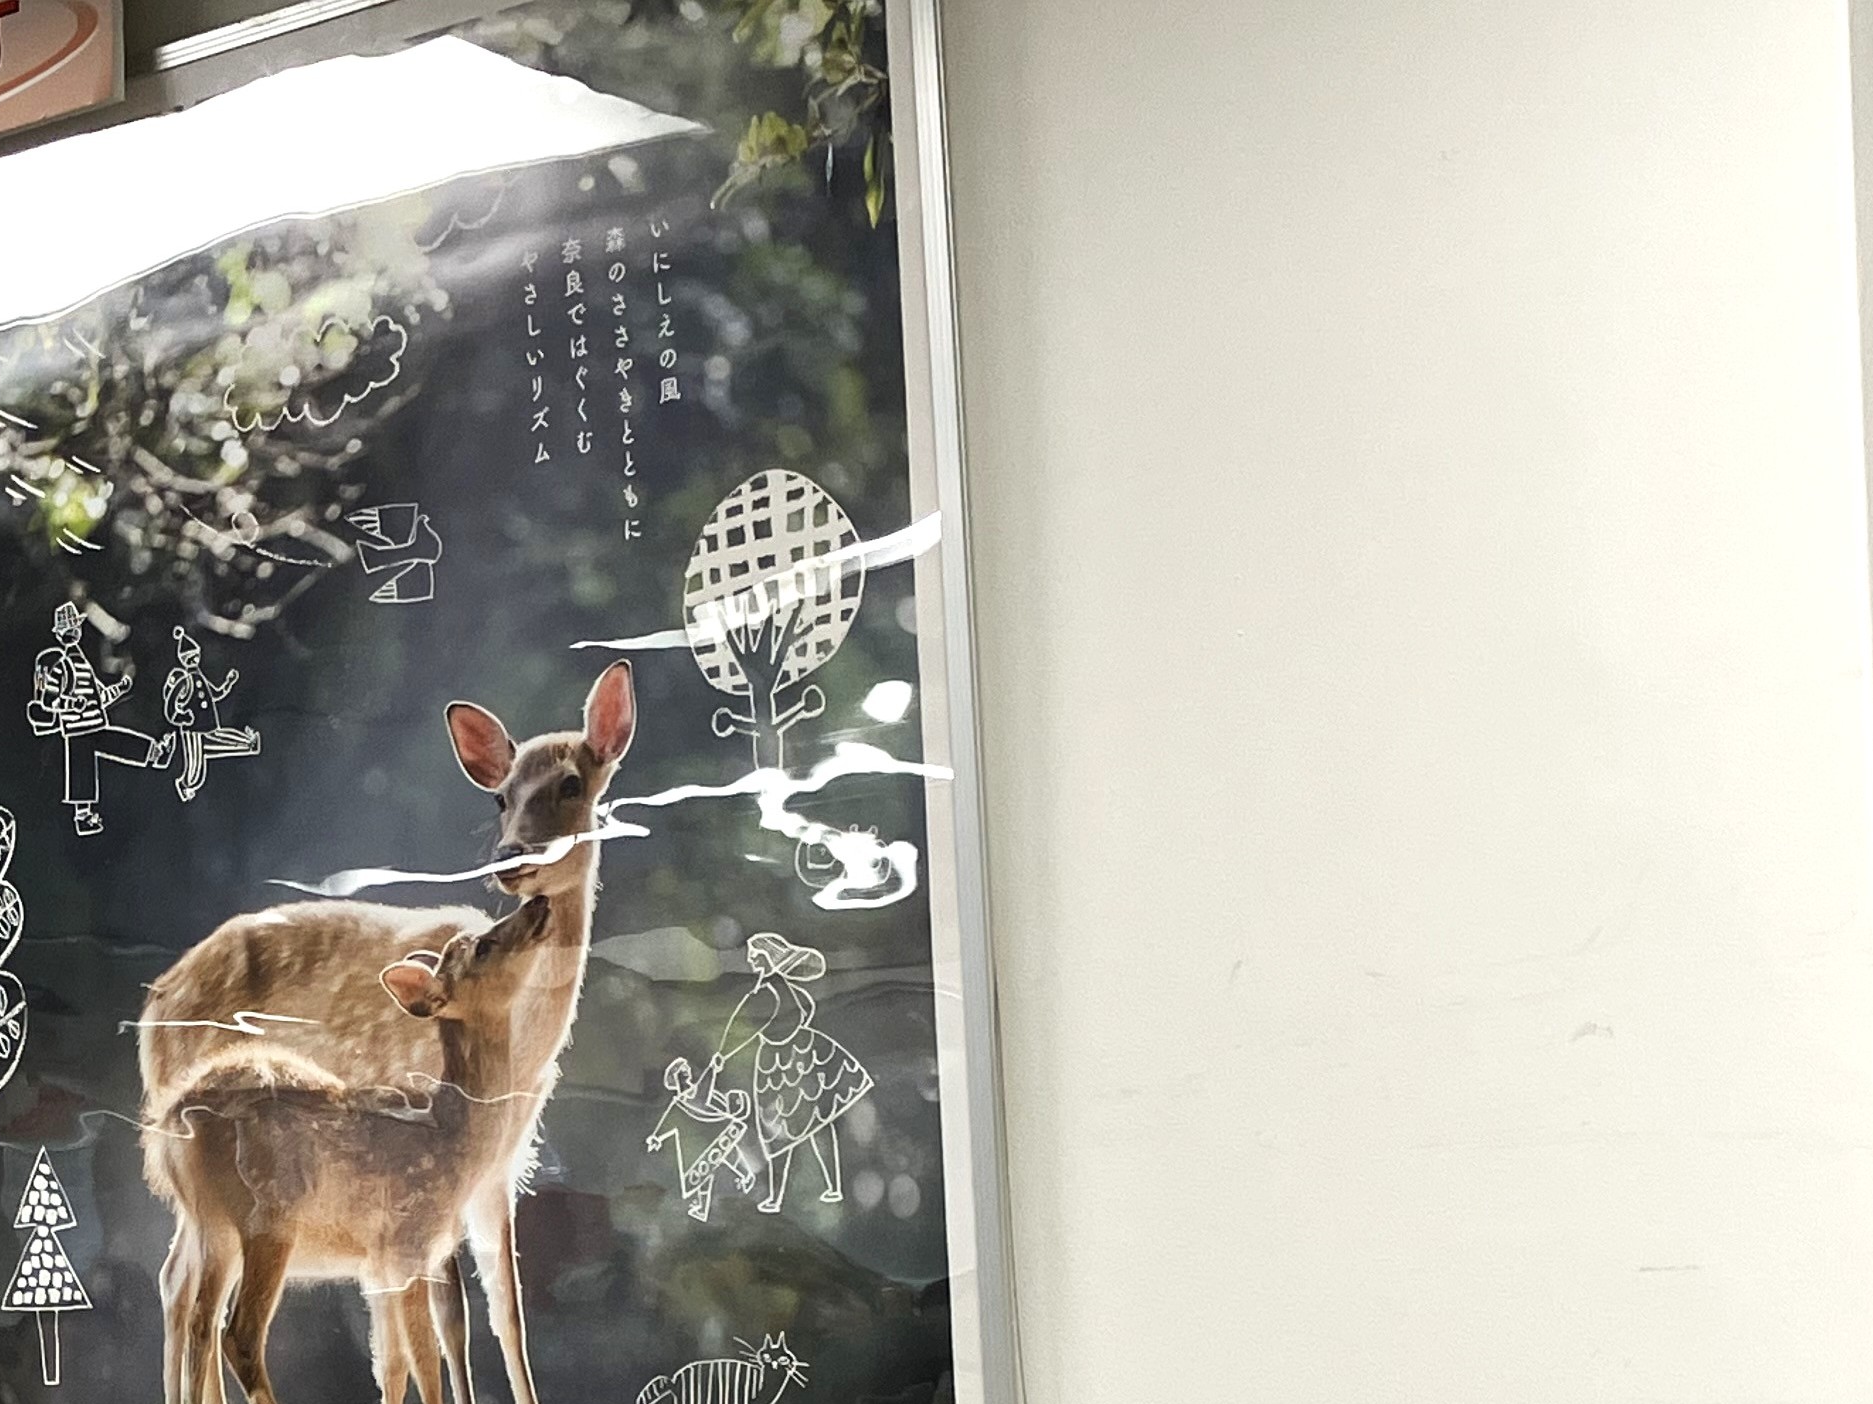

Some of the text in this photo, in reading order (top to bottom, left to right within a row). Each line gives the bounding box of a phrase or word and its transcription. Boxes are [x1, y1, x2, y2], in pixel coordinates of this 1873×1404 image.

[520, 251, 551, 464] やさしいリズム
[560, 238, 594, 454] 奈良ではぐくむ
[605, 226, 643, 541] 森のささやきとともに
[650, 218, 682, 405] いにしえの風
